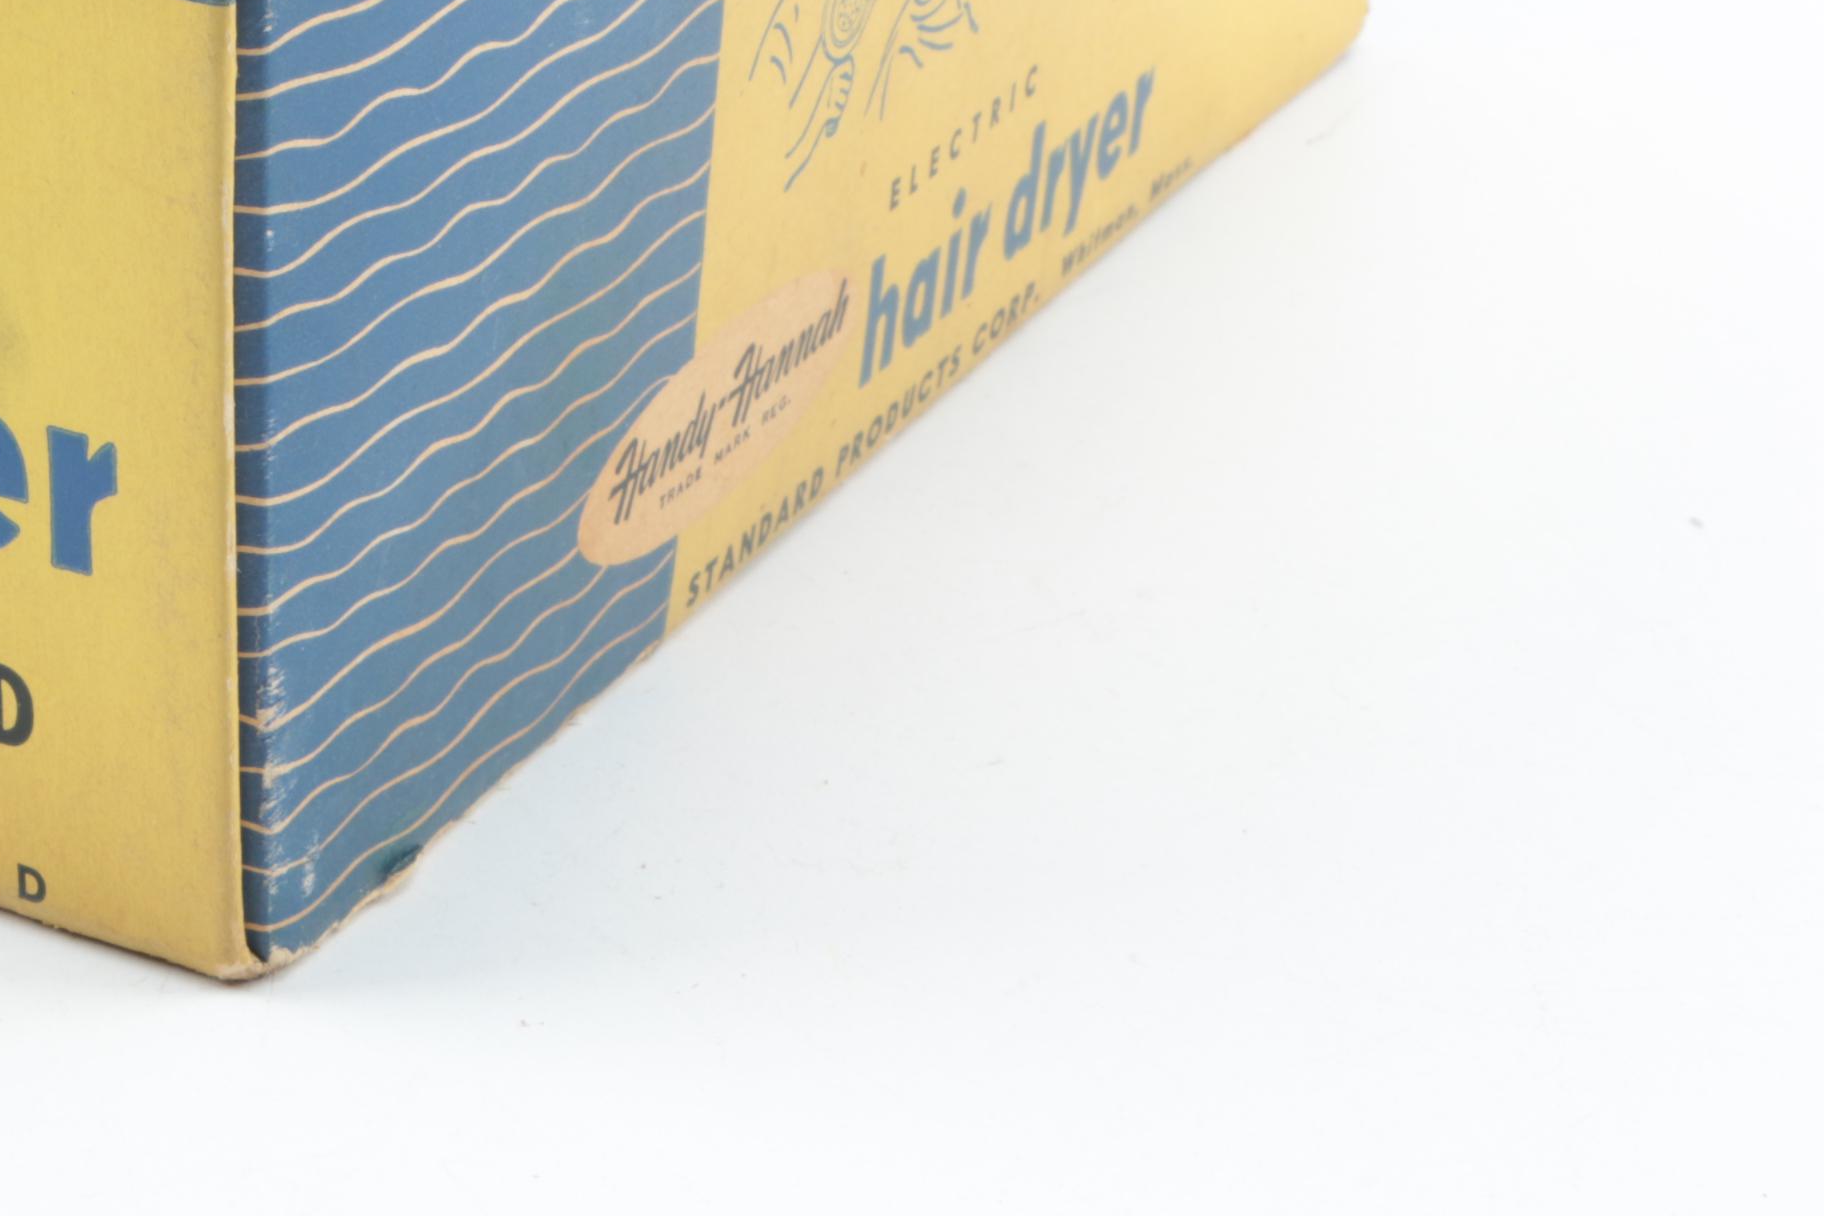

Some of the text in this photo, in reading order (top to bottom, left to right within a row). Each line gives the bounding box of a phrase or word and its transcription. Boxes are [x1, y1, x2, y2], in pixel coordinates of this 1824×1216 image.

[858, 65, 1155, 389] hair dryer
[889, 64, 1038, 211] ELECTRIC
[608, 277, 849, 525] Handy-Hannah
[659, 396, 792, 509] TRADE MARK REG.
[686, 466, 824, 608] STANDARD
[835, 345, 962, 478] PRODUCTS
[971, 282, 1040, 356] CORP.
